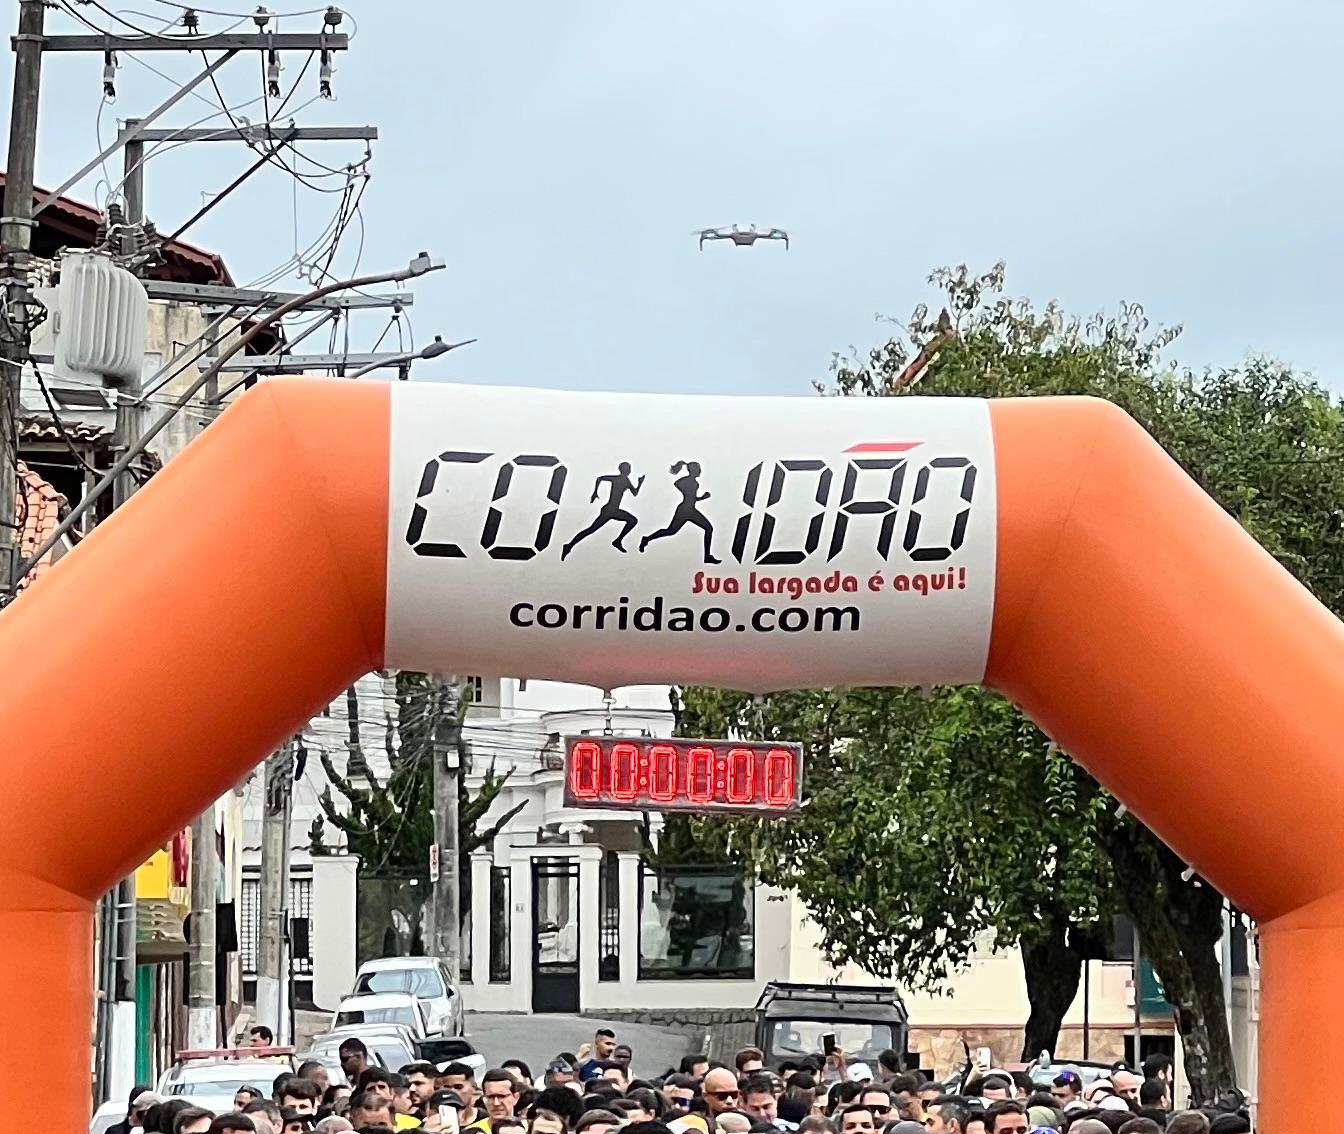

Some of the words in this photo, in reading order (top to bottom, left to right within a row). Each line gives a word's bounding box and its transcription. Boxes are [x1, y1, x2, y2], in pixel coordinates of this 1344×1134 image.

[692, 571, 739, 595] Sua
[749, 570, 858, 600] largada
[867, 568, 884, 593] é
[893, 565, 966, 597] aqui!
[510, 596, 861, 633] corridao.com
